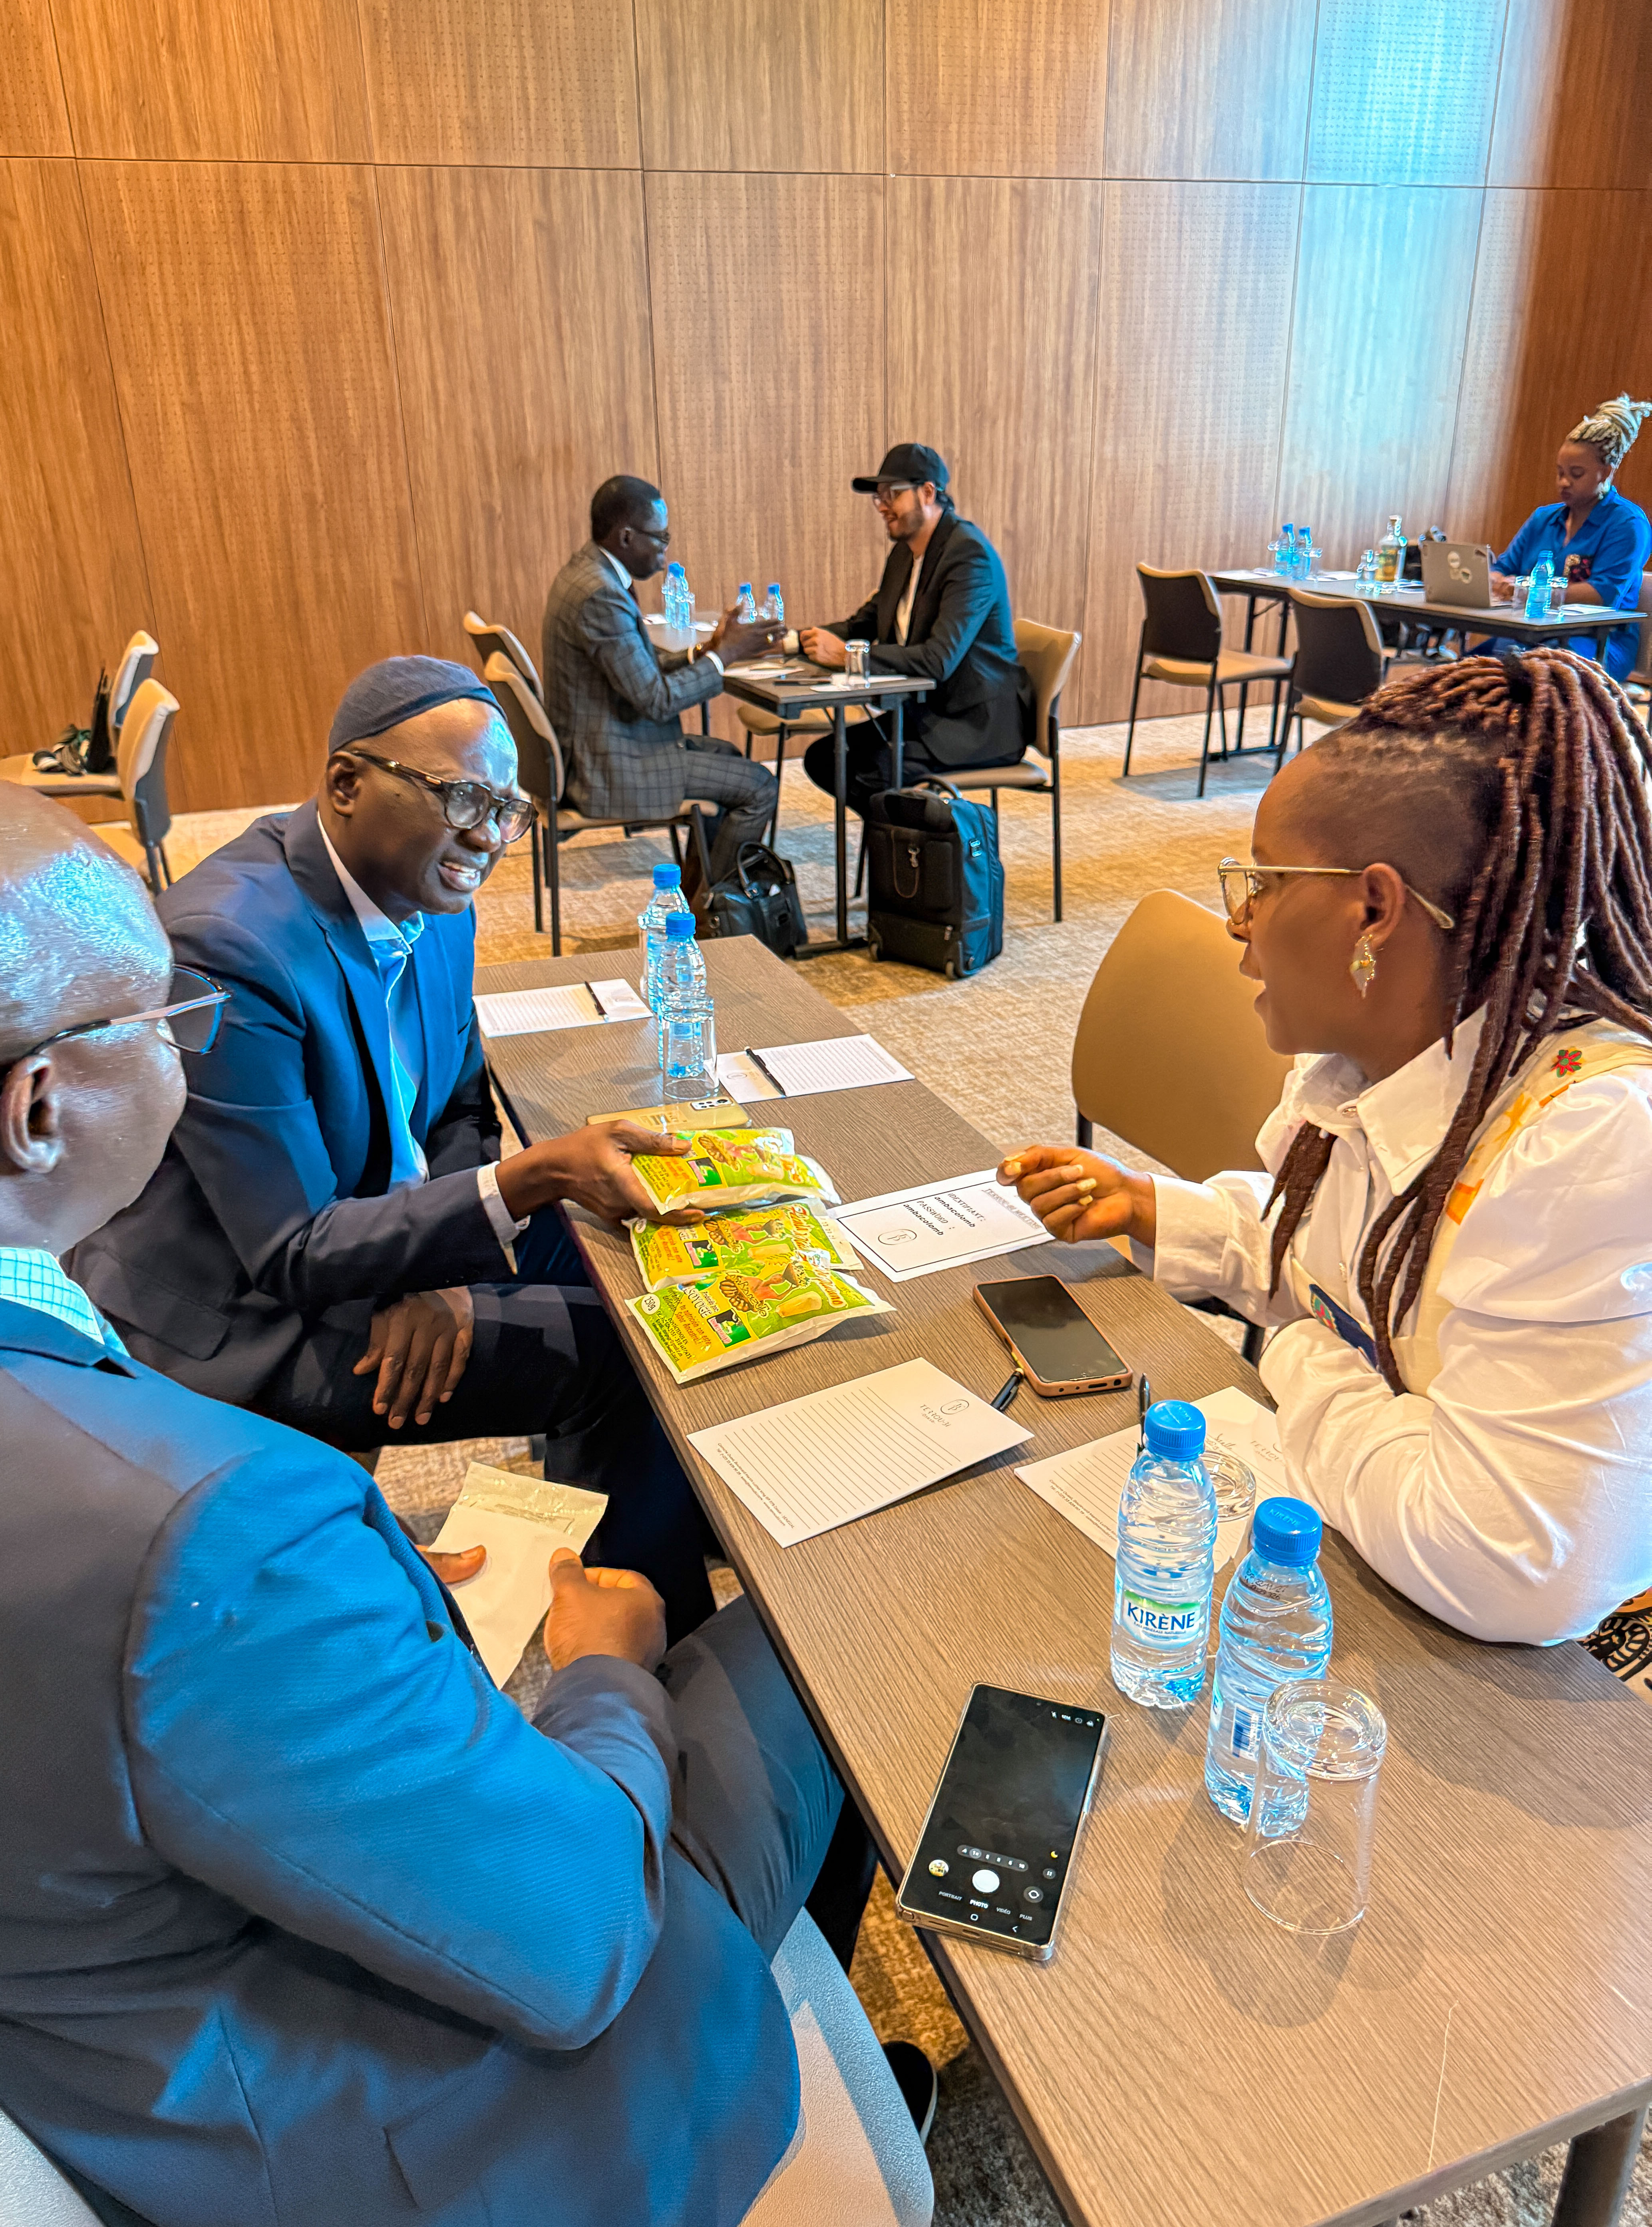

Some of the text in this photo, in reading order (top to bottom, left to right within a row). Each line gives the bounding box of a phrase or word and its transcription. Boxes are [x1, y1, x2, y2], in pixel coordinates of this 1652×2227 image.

[903, 1204, 944, 1236] ambacolomb
[916, 1201, 948, 1223] PASSWORD
[643, 1297, 657, 1310] 250g
[1127, 1601, 1195, 1630] KIRÈNE
[938, 1891, 962, 1901] PORTRAIT
[970, 1899, 989, 1909] PHOTO
